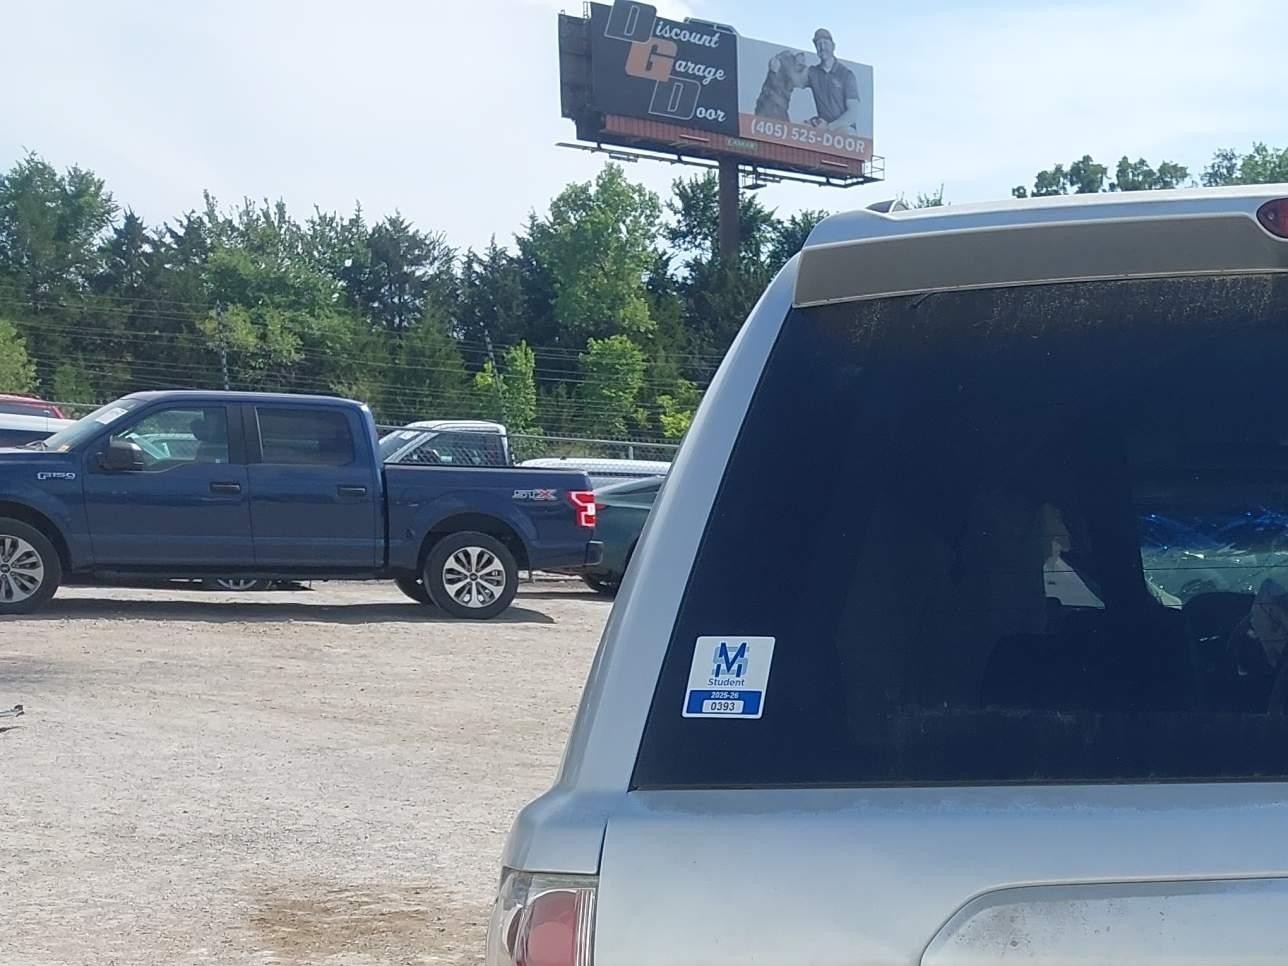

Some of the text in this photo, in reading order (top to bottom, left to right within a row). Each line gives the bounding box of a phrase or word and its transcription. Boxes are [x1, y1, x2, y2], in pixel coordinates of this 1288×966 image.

[603, 0, 721, 48] Discount
[625, 37, 727, 85] Garage
[648, 74, 727, 121] Door
[751, 118, 866, 153] (405) 525-DOOR
[707, 678, 745, 687] Student
[710, 691, 740, 699] 2025-26
[710, 701, 736, 711] 0393
